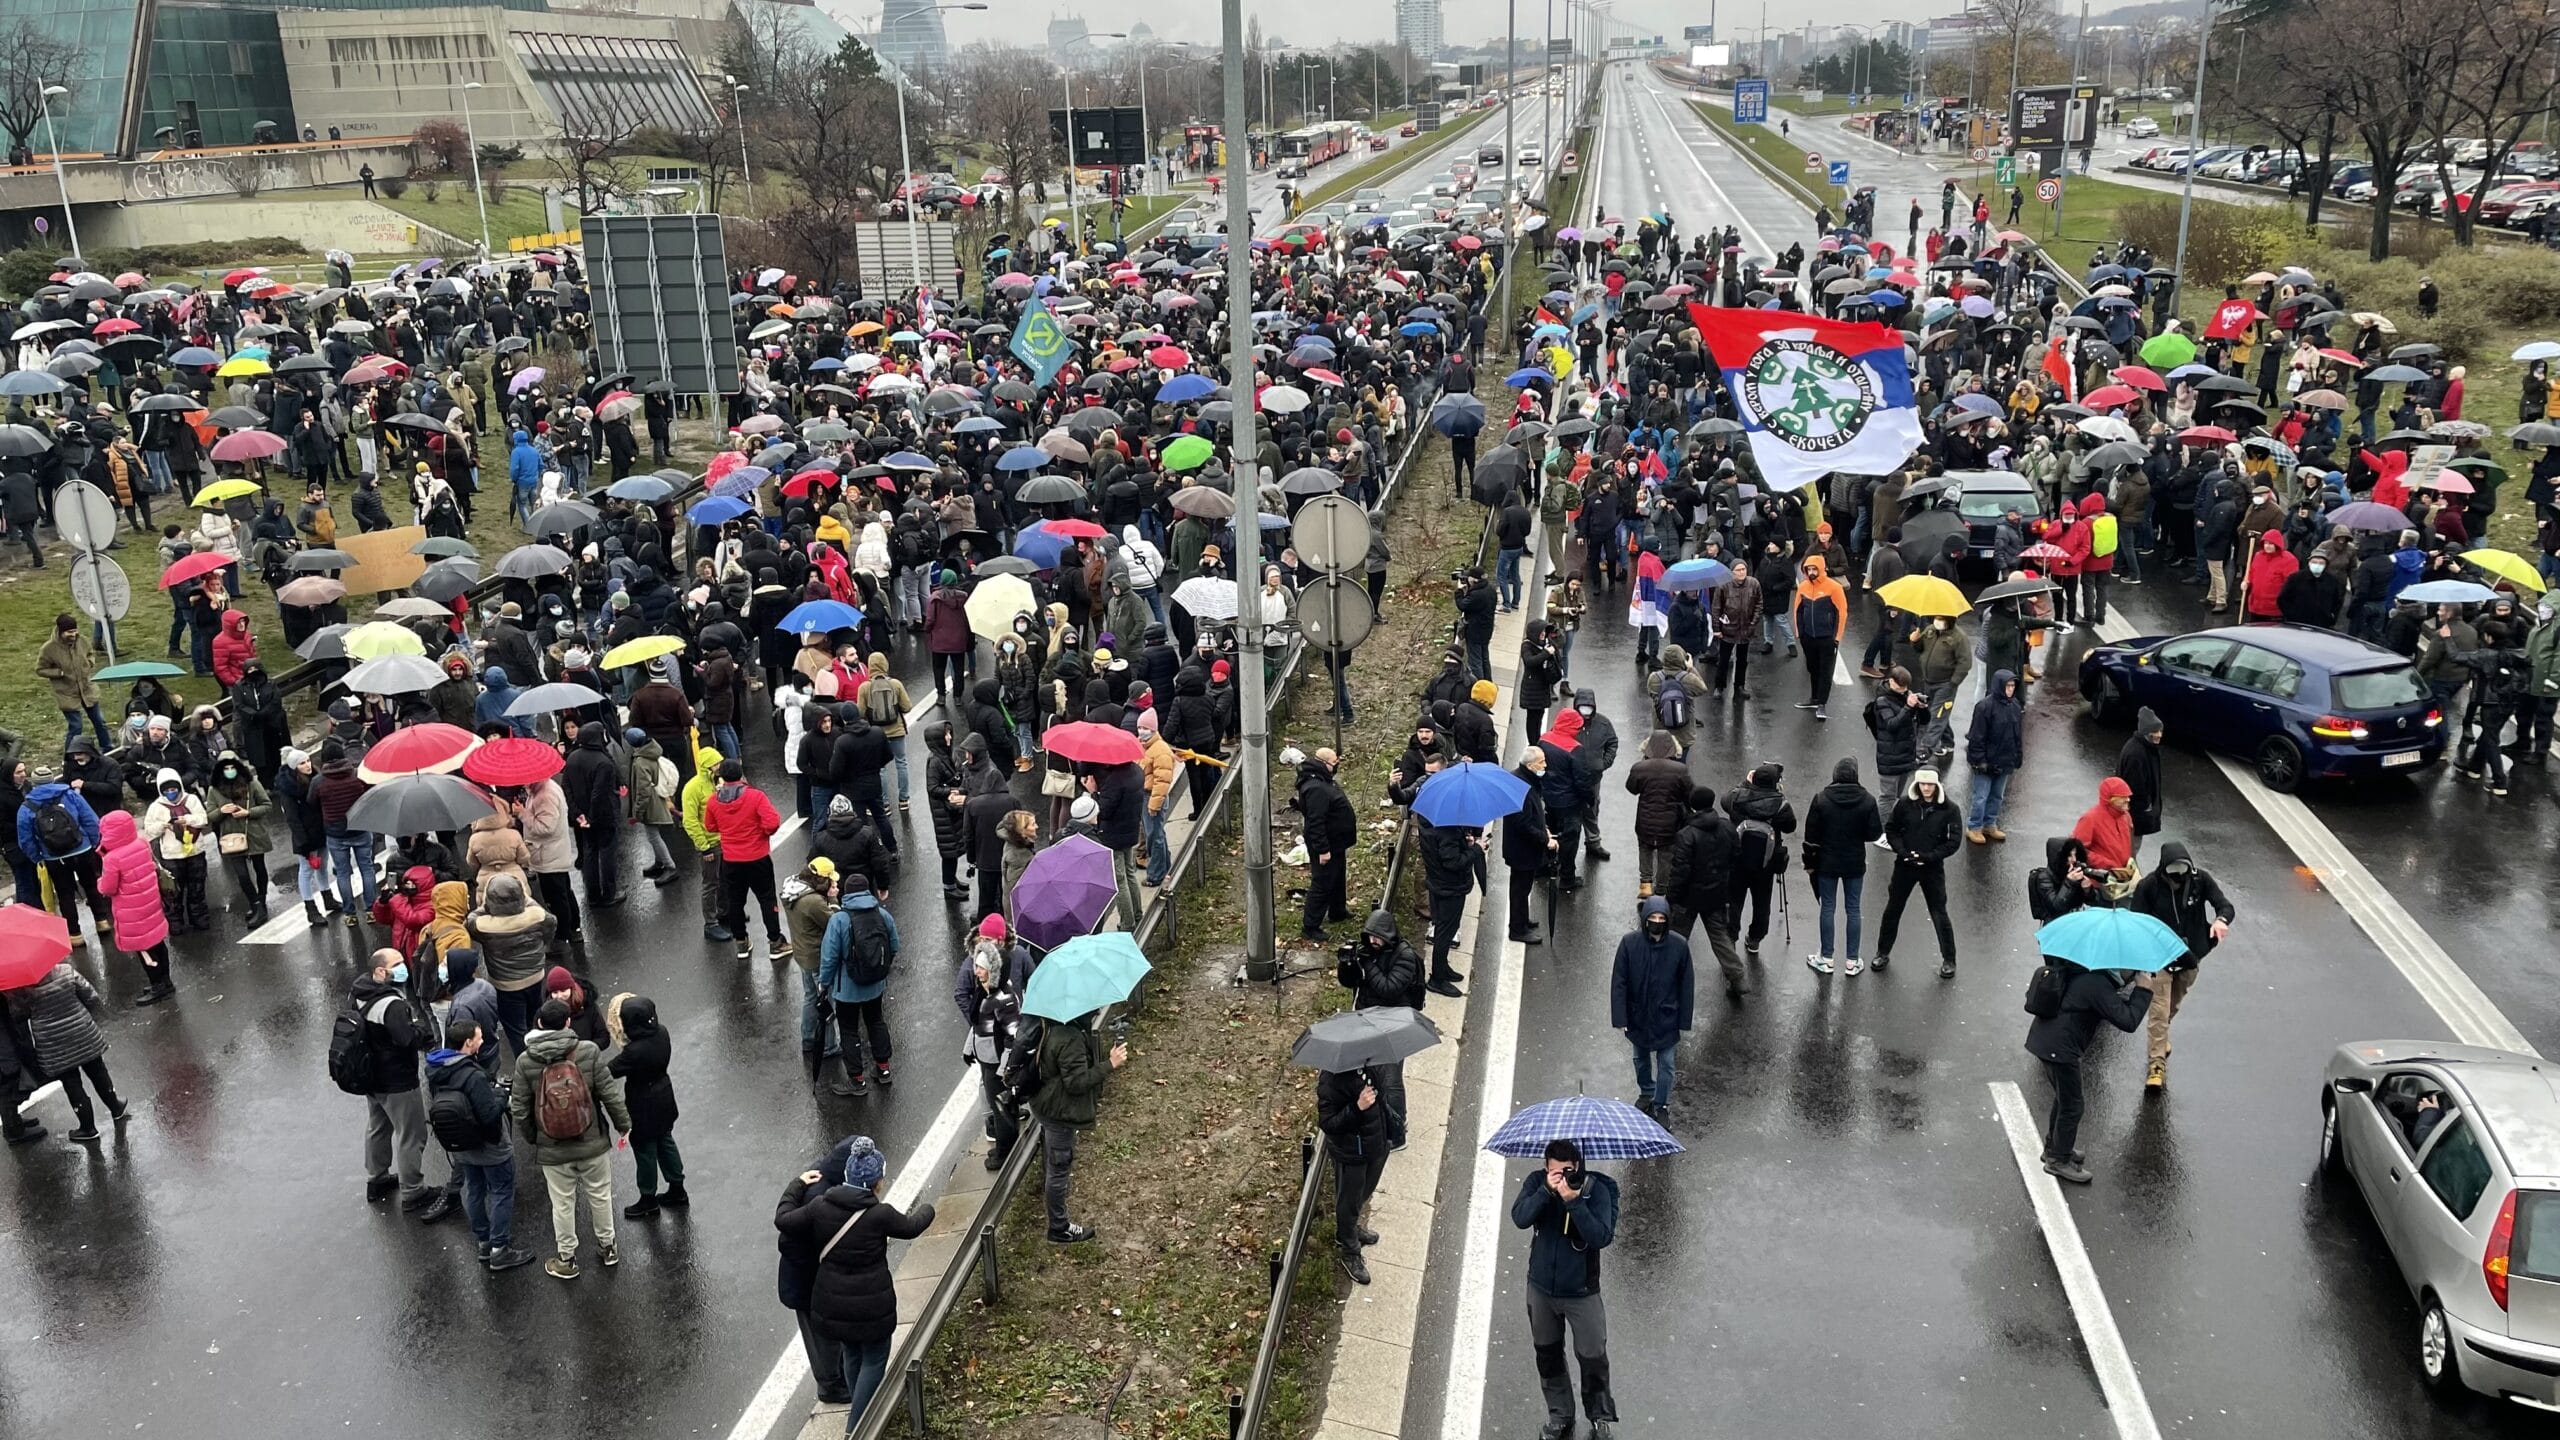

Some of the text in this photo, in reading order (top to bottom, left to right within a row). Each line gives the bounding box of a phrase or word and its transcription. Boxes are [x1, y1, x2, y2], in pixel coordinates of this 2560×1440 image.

[1974, 149, 1985, 158] 40
[2040, 185, 2055, 197] 50
[1774, 340, 1791, 351] ЗА
[1791, 342, 1835, 360] КРАЉА
[1750, 347, 1775, 370] БОГА
[1835, 355, 1848, 367] И
[1746, 370, 1757, 378] У
[1745, 382, 1770, 420] ВЕРОМ
[1767, 419, 1778, 429] С
[1788, 428, 1855, 450] ЕКОЧЕТА
